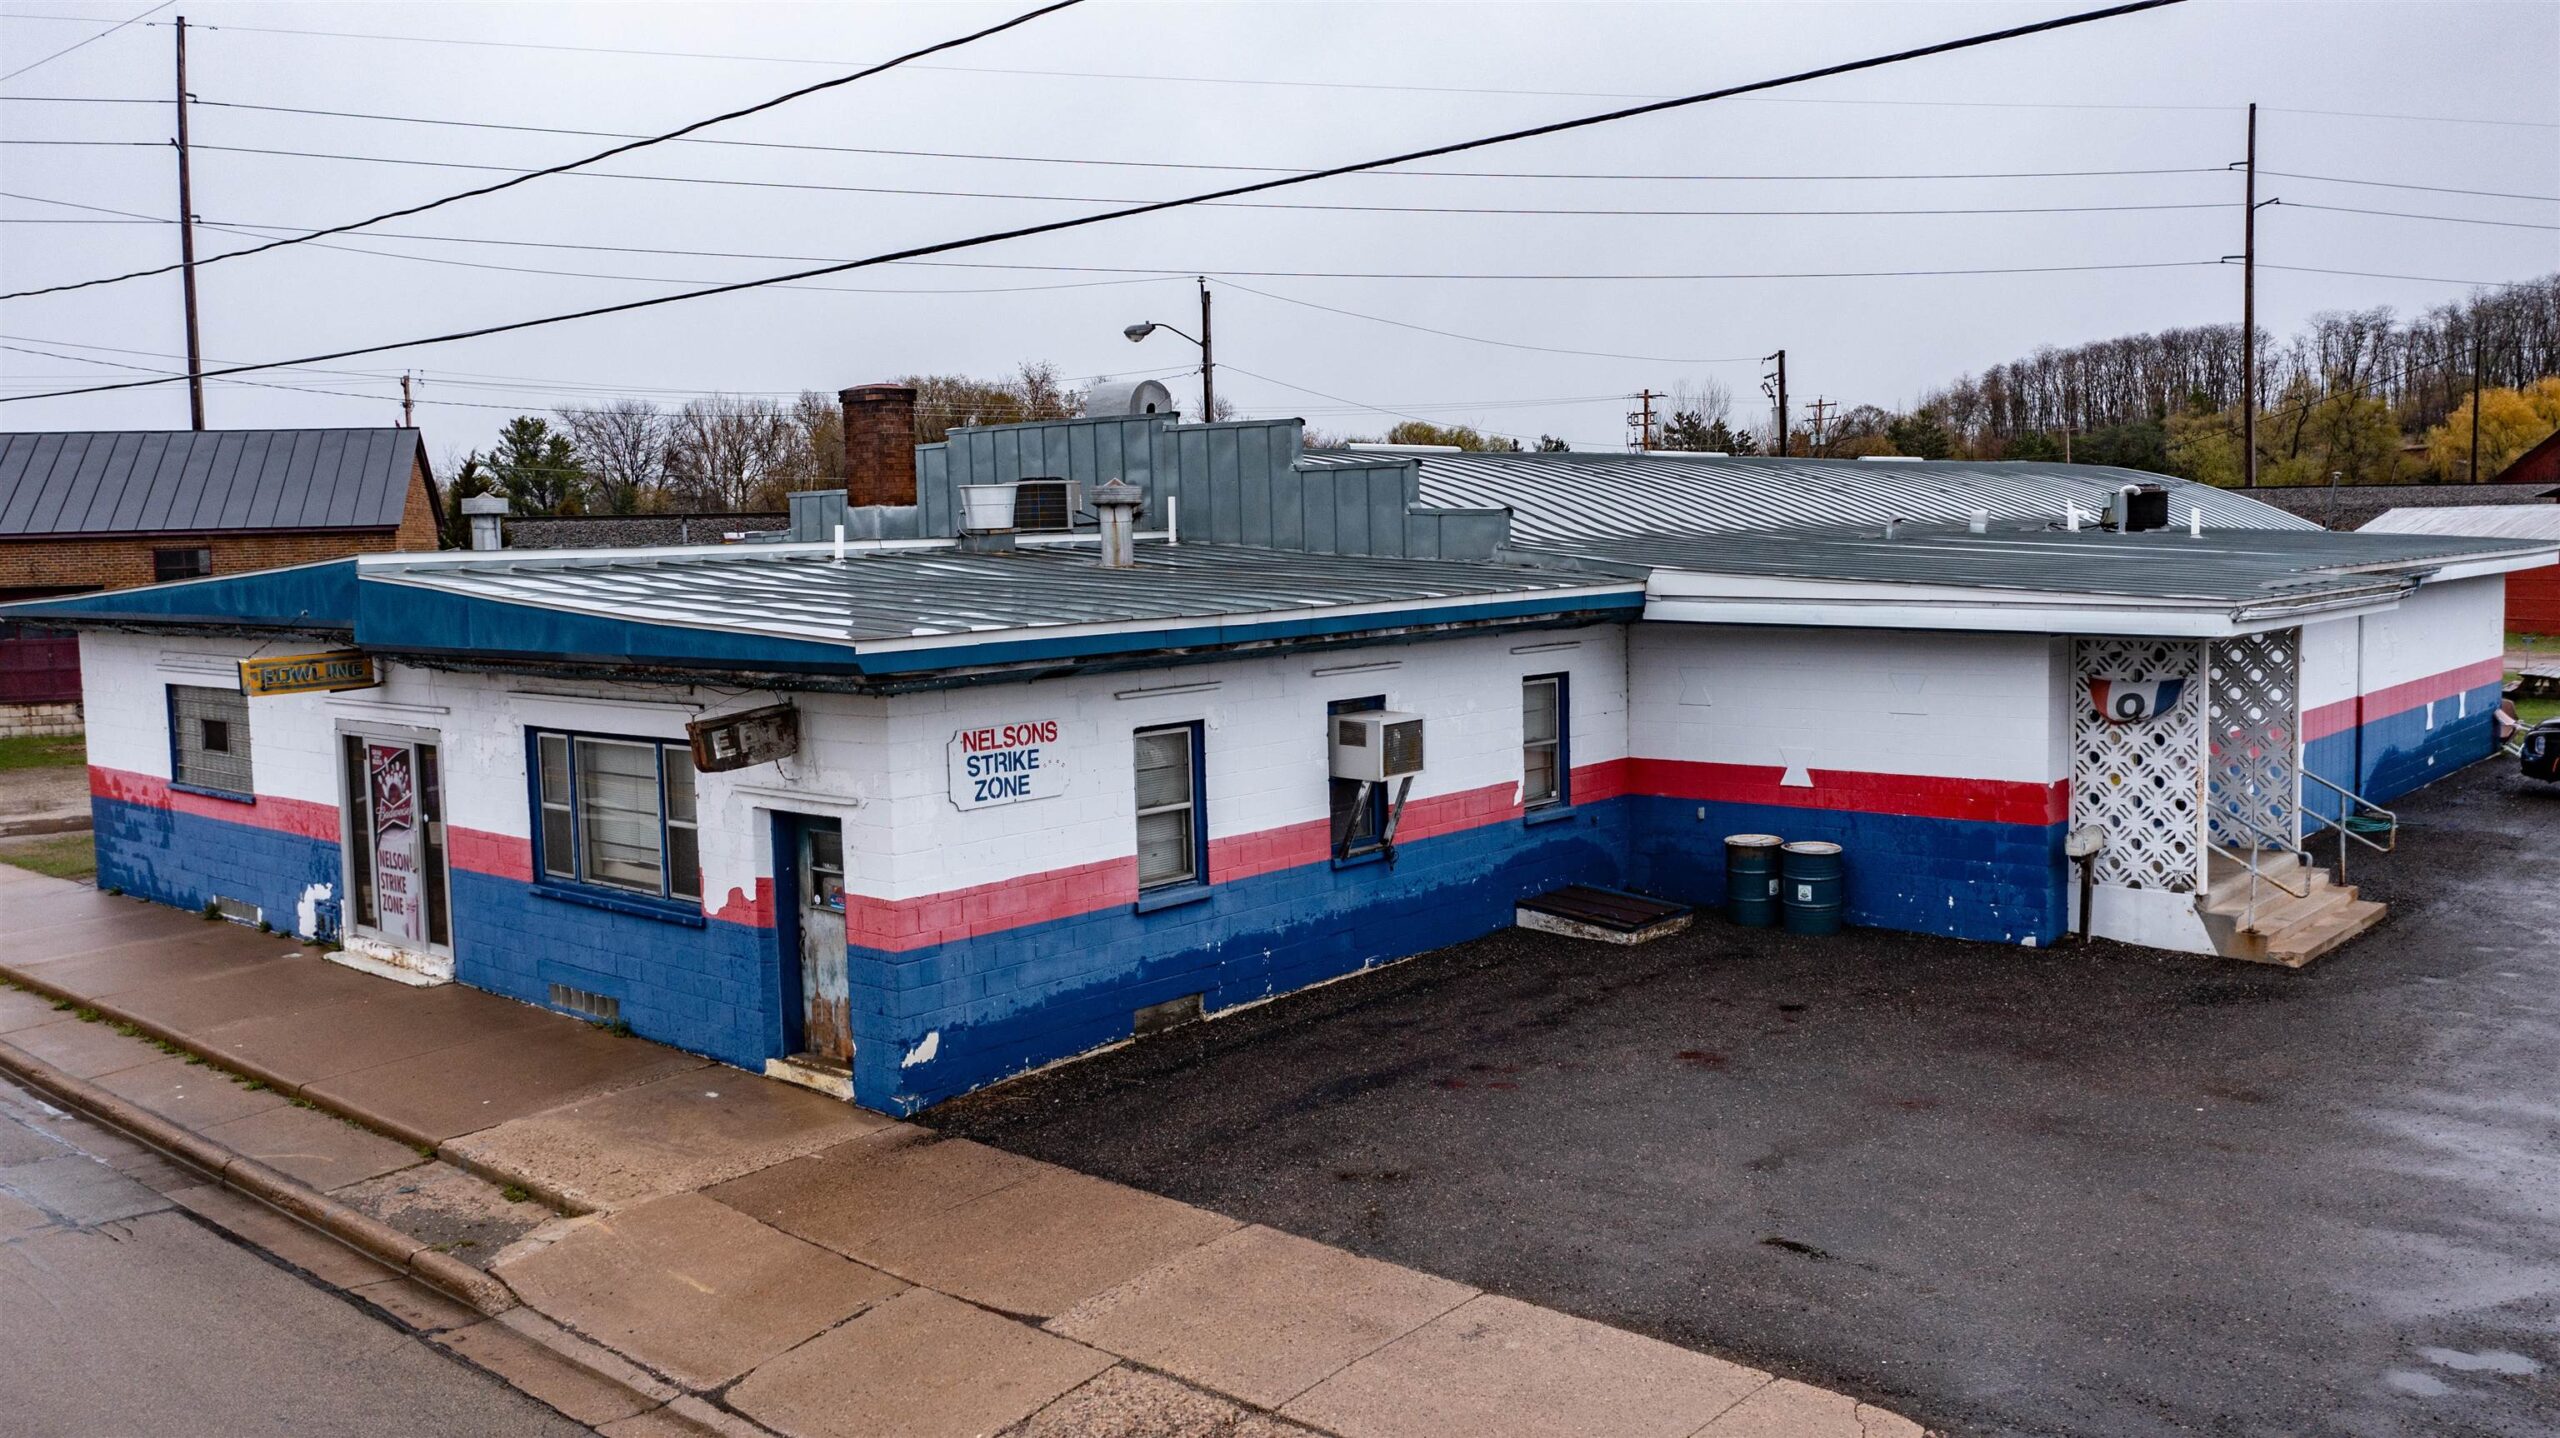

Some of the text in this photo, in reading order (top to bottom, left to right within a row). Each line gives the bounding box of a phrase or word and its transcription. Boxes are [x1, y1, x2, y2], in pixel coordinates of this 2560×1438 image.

[962, 721, 1058, 753] NELSONS
[966, 749, 1040, 775] STRIKE
[974, 774, 1031, 802] ZONE
[380, 872, 407, 894] STRIKE
[382, 894, 404, 915] ZONE
